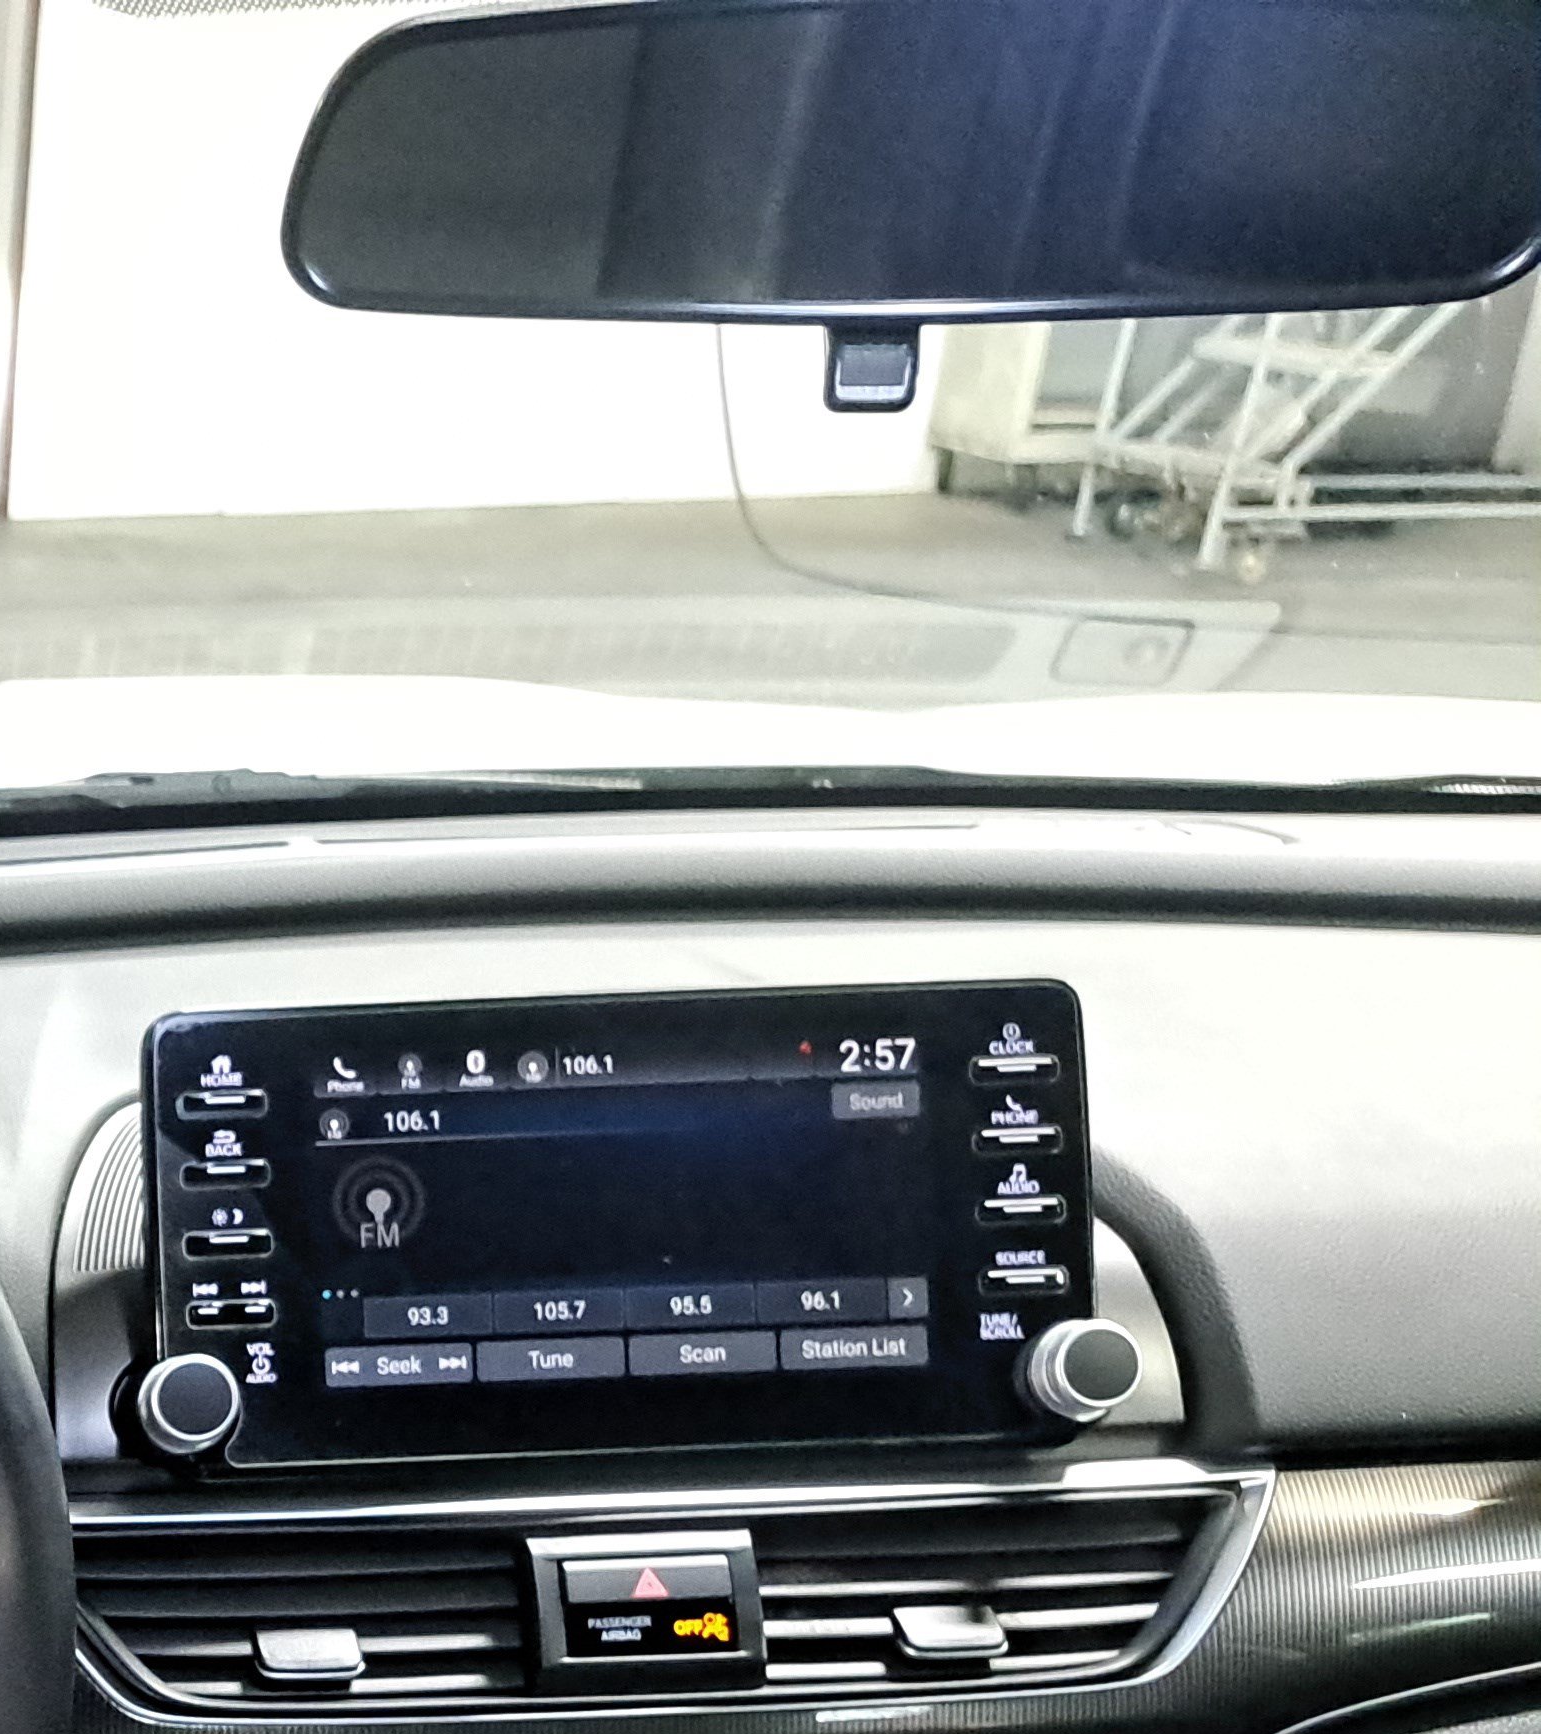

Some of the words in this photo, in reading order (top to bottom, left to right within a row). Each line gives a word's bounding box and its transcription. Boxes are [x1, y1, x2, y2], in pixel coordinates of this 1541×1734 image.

[839, 1037, 916, 1074] 2:57
[989, 1040, 1035, 1055] CLOCK
[562, 1054, 614, 1076] 106.1
[849, 1092, 905, 1111] Sound
[384, 1110, 440, 1132] 106.1
[991, 1110, 1039, 1125] PHONE
[205, 1143, 242, 1157] BACK
[997, 1180, 1040, 1195] AUDIO
[360, 1222, 400, 1249] FM
[996, 1250, 1046, 1266] SOURCE
[533, 1300, 586, 1321] 105.7
[669, 1295, 712, 1315] 95.5
[800, 1290, 841, 1311] 96.1
[407, 1306, 450, 1326] 93.3
[246, 1343, 275, 1355] VOL
[679, 1344, 726, 1365] Scan
[801, 1339, 868, 1359] Station
[871, 1337, 906, 1357] List
[376, 1355, 422, 1375] Seek
[527, 1350, 574, 1369] Tune
[587, 1615, 652, 1630] PASSENGER
[673, 1619, 703, 1636] OFF
